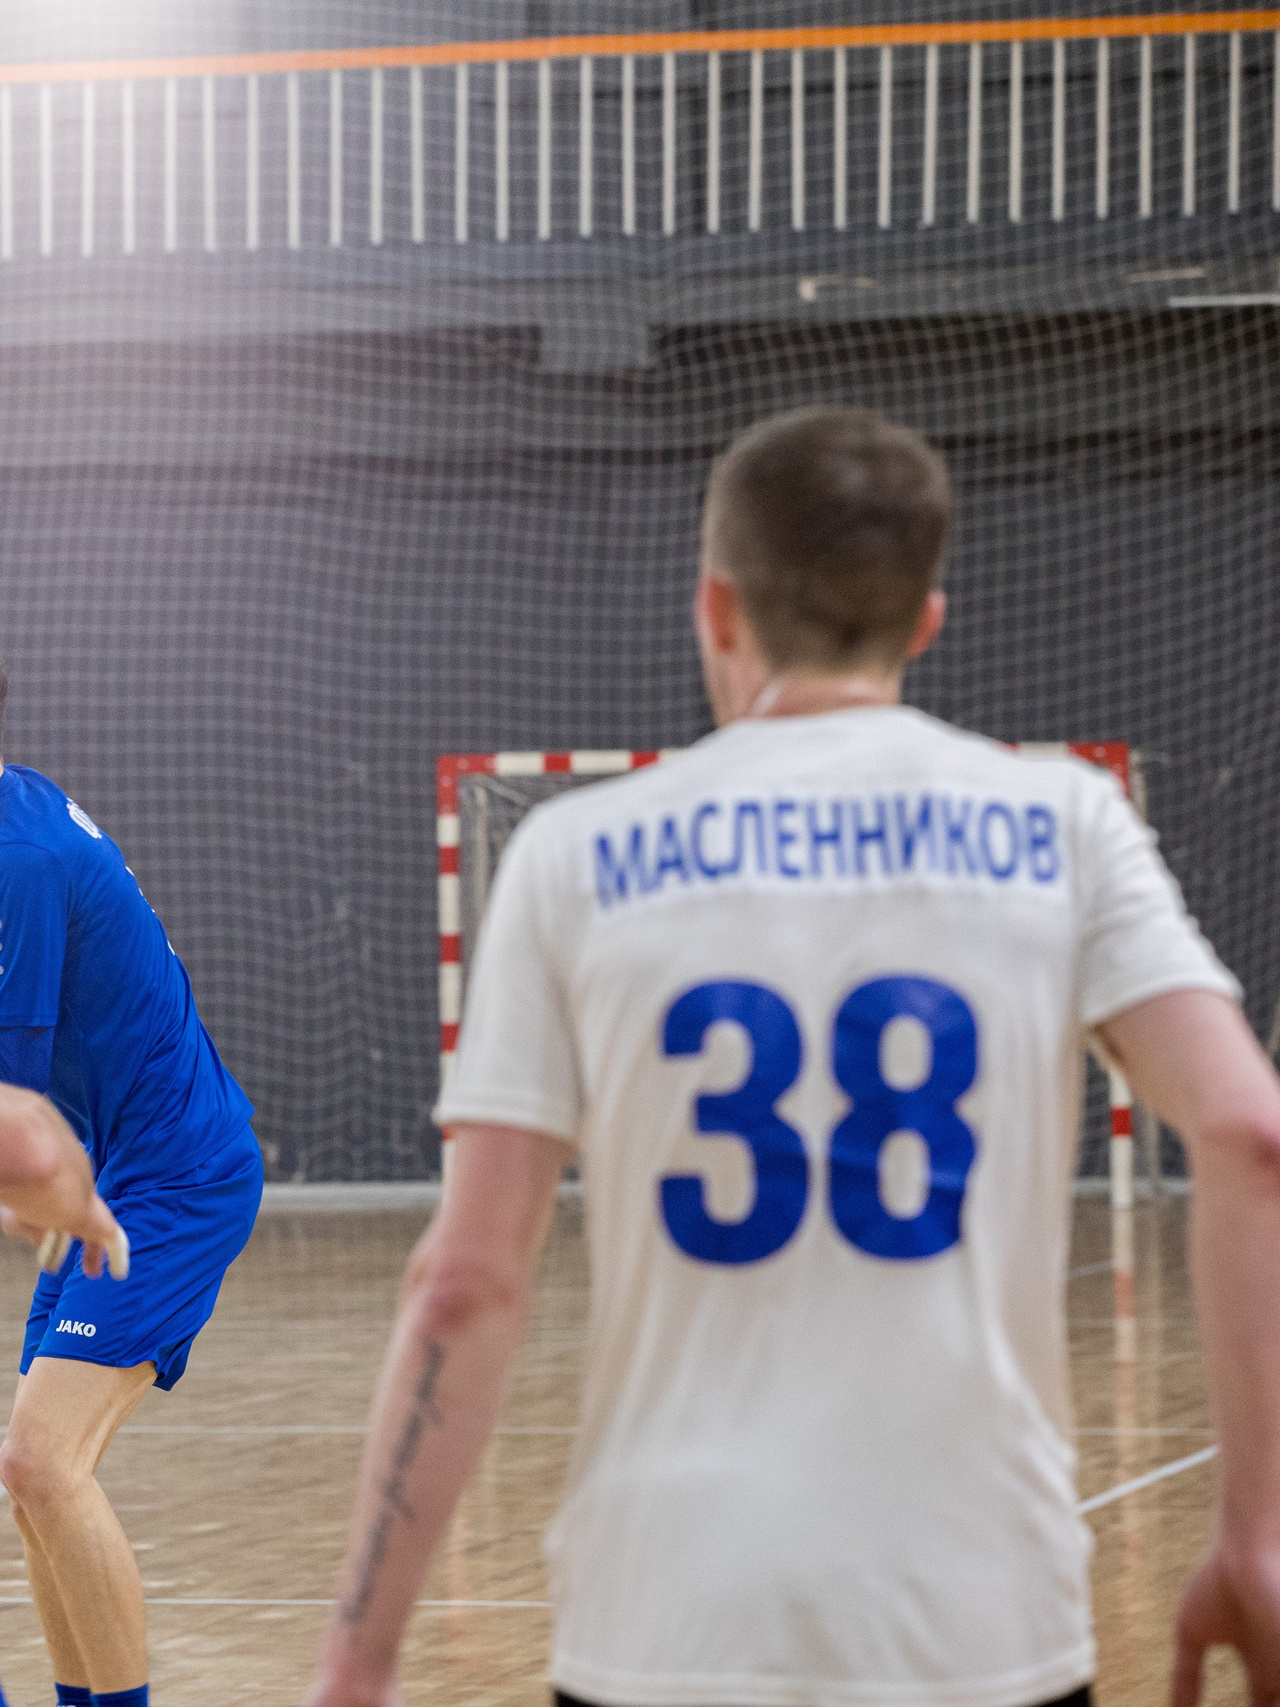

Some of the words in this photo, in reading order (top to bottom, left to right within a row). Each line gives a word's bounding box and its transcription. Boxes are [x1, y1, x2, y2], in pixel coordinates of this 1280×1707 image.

[594, 791, 1062, 908] МАСЛЕННИКОВ
[658, 973, 980, 1266] 38
[55, 1319, 97, 1338] JAKO
